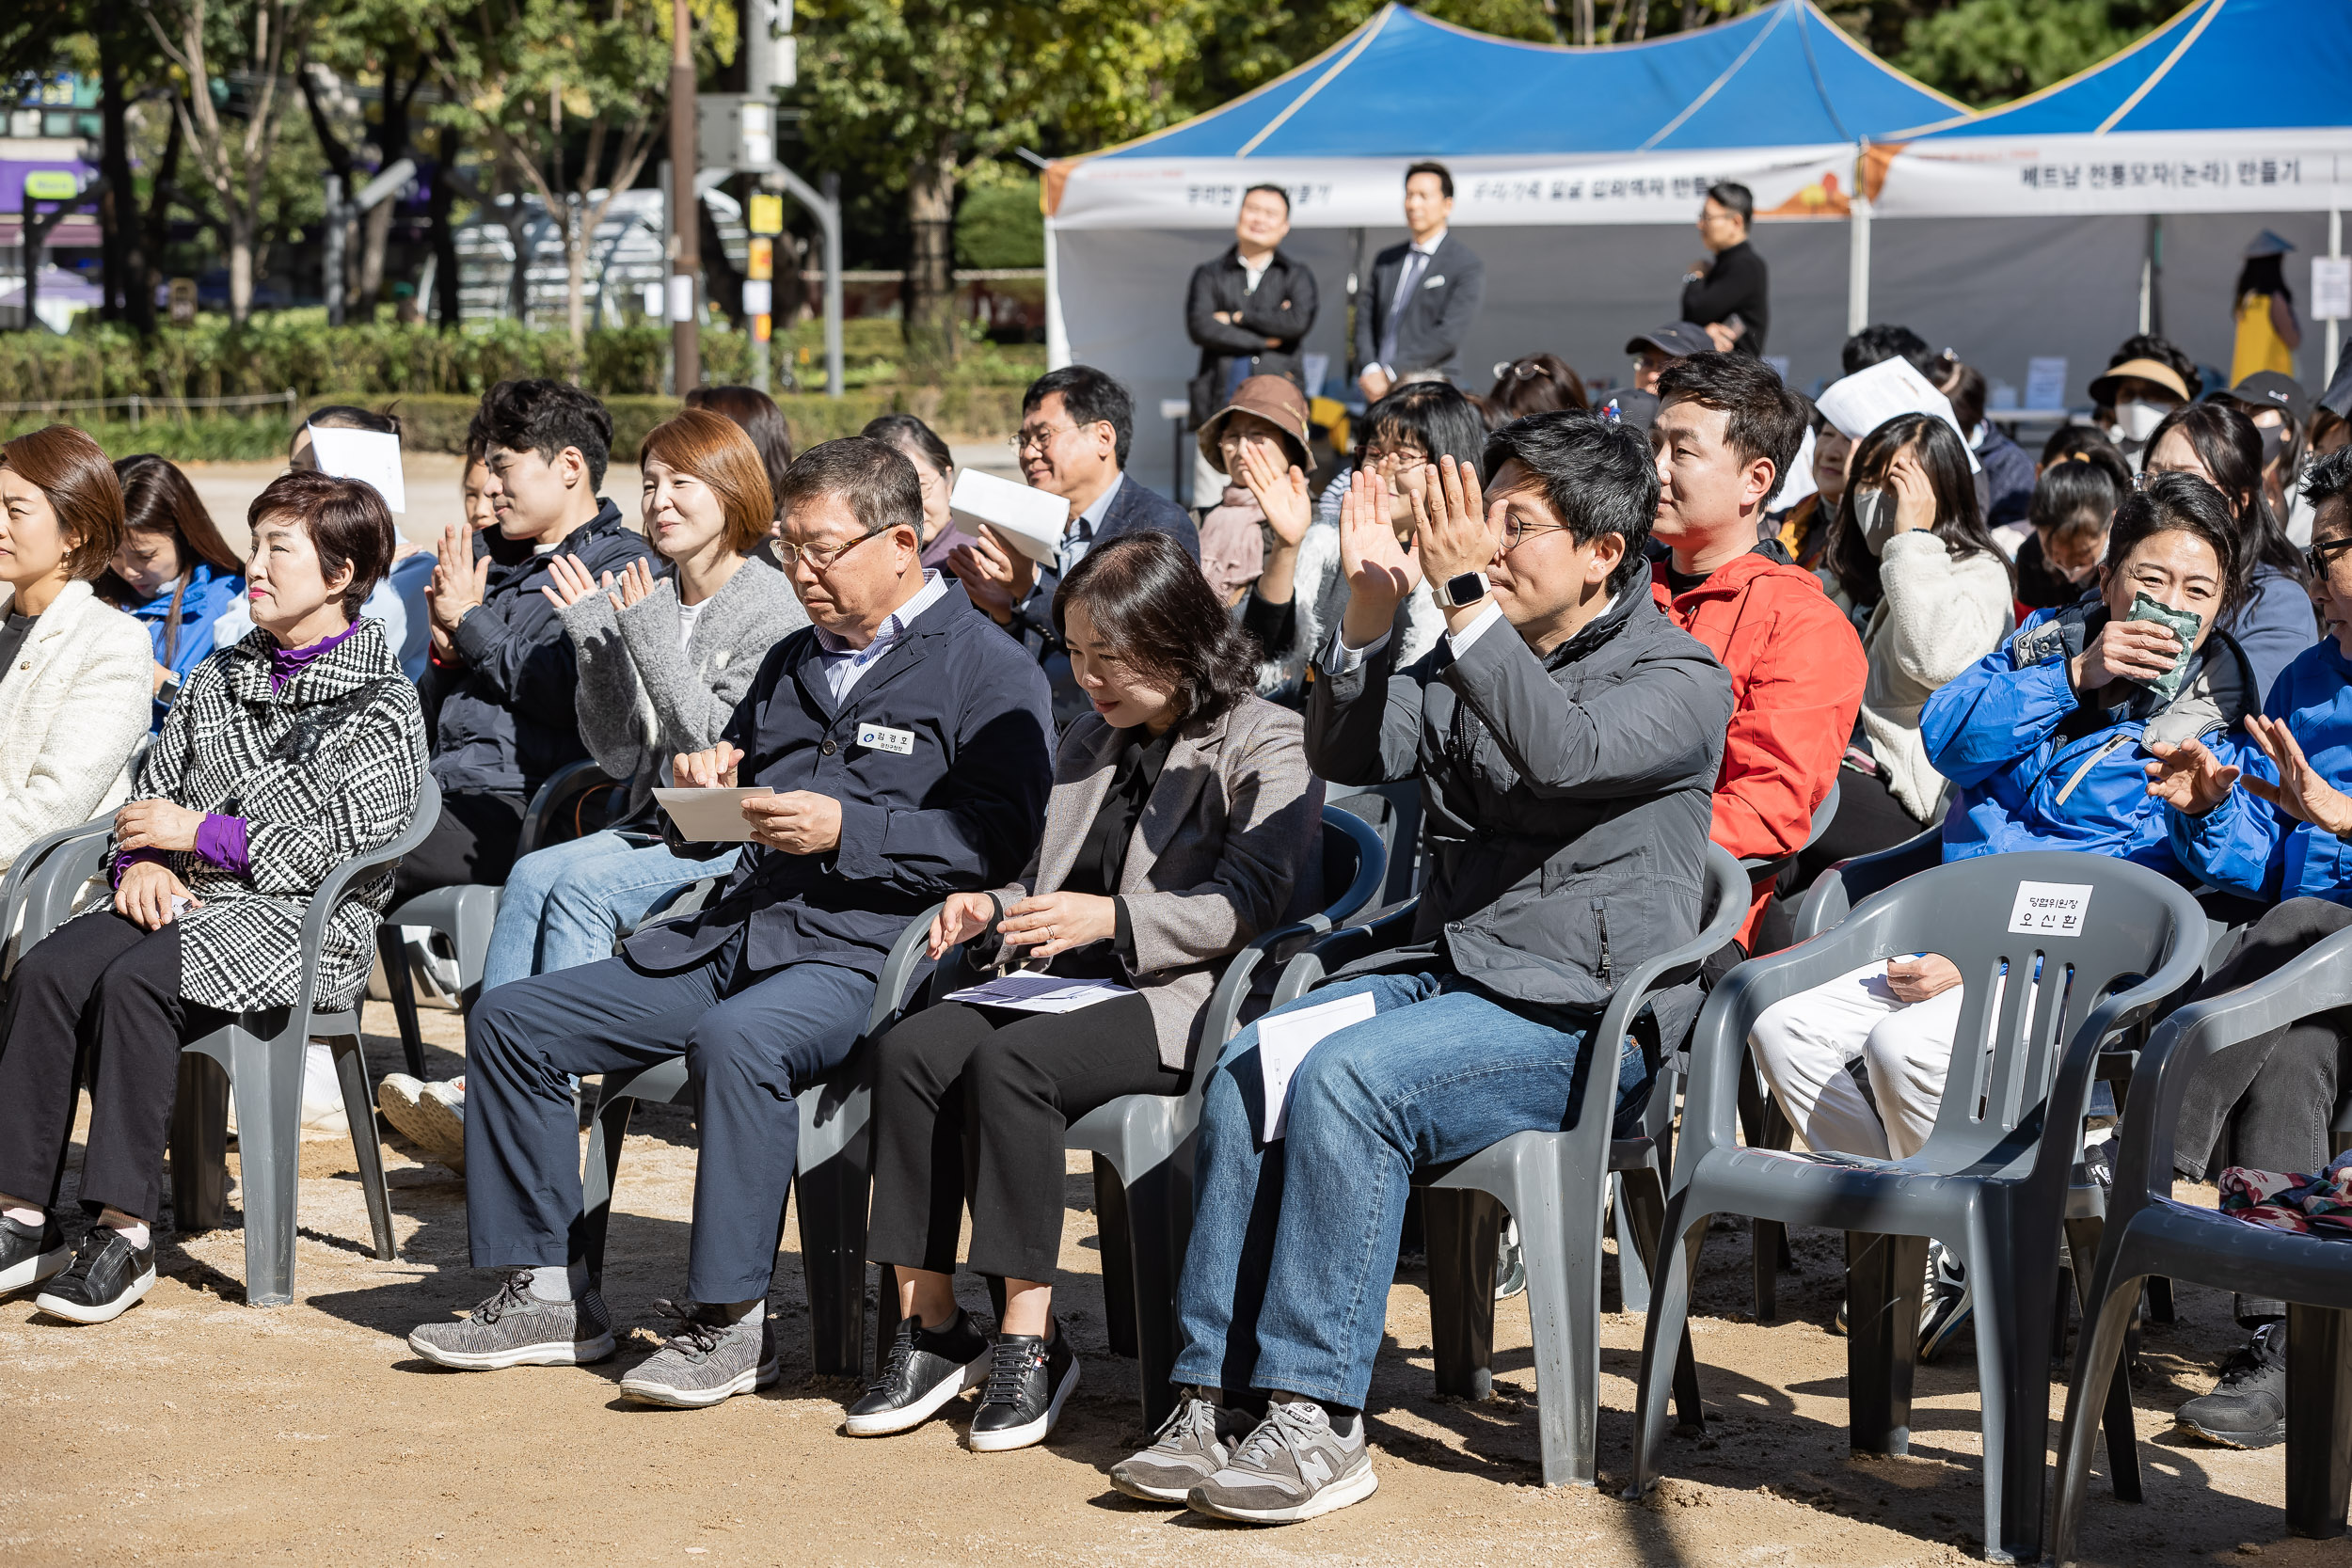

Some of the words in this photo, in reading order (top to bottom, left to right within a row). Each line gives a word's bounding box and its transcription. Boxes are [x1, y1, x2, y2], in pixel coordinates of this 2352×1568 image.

[2021, 164, 2079, 188] 베트남
[2238, 158, 2300, 186] 만들기
[1673, 174, 1729, 198] 만들
[2029, 896, 2078, 910] 당협위원장
[2019, 912, 2077, 929] 오신환
